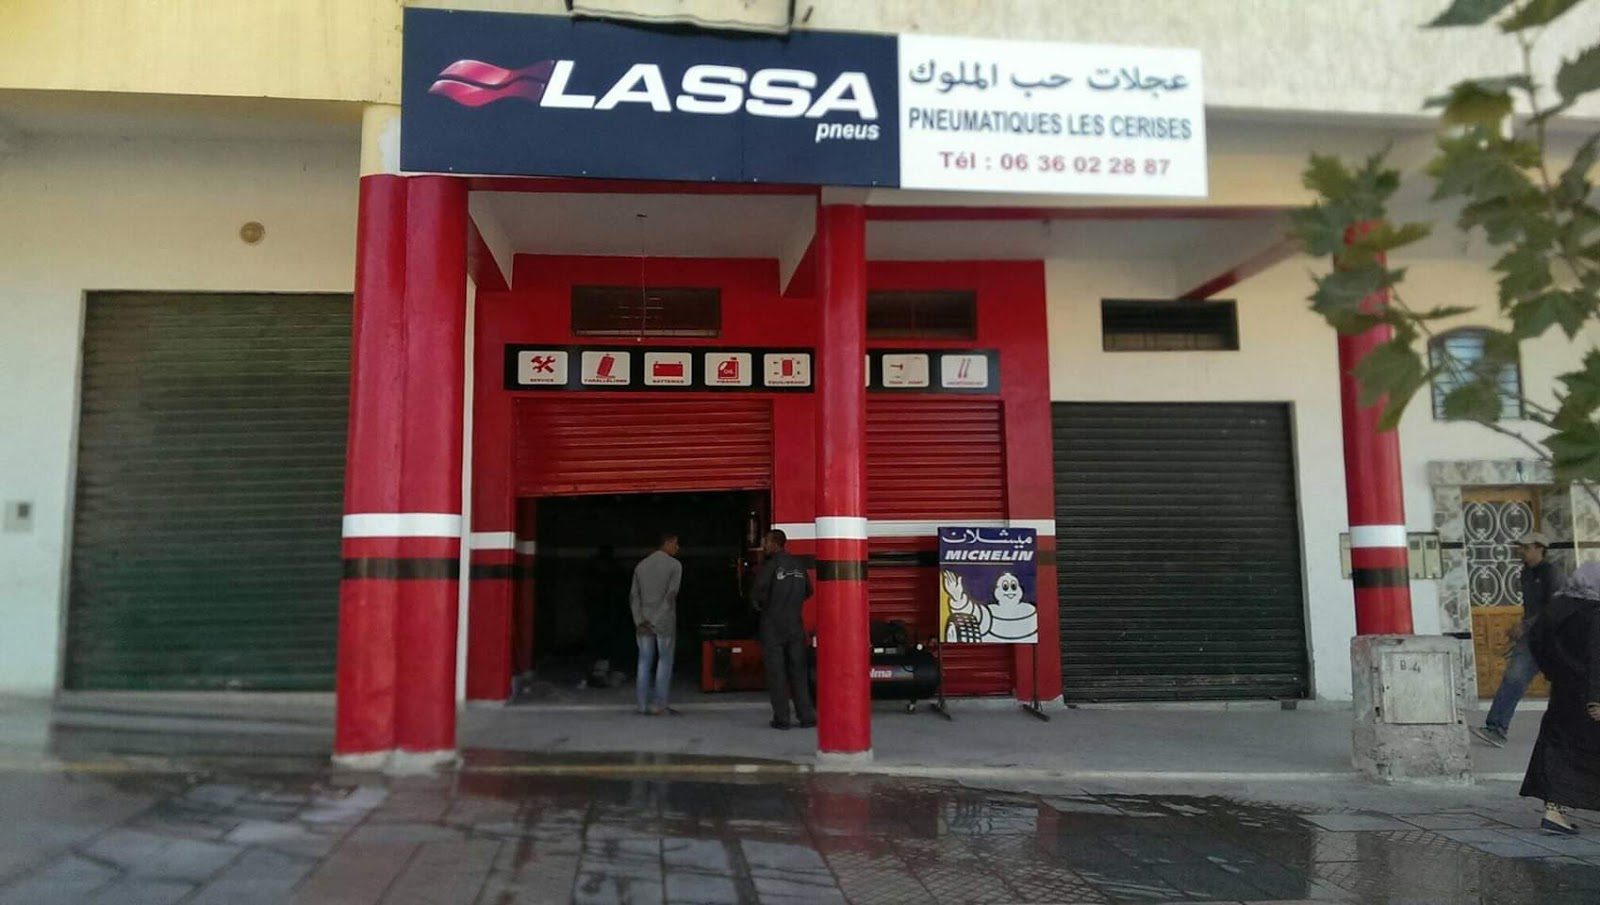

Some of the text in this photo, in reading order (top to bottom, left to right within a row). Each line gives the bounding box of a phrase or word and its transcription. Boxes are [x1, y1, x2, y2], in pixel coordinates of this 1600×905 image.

[540, 60, 879, 119] LASSA
[909, 59, 1189, 98] عجلات حب الملوك
[815, 121, 880, 142] pneus
[909, 107, 1192, 140] PNEUMATIQUES LES CERISES
[939, 151, 975, 170] Tél
[1000, 153, 1028, 171] 06
[1038, 154, 1066, 172] 36
[1073, 156, 1101, 173] 02
[1108, 157, 1136, 174] 28
[1144, 158, 1171, 175] 87
[944, 550, 1034, 561] MICHELIN
[870, 668, 892, 679] lma
